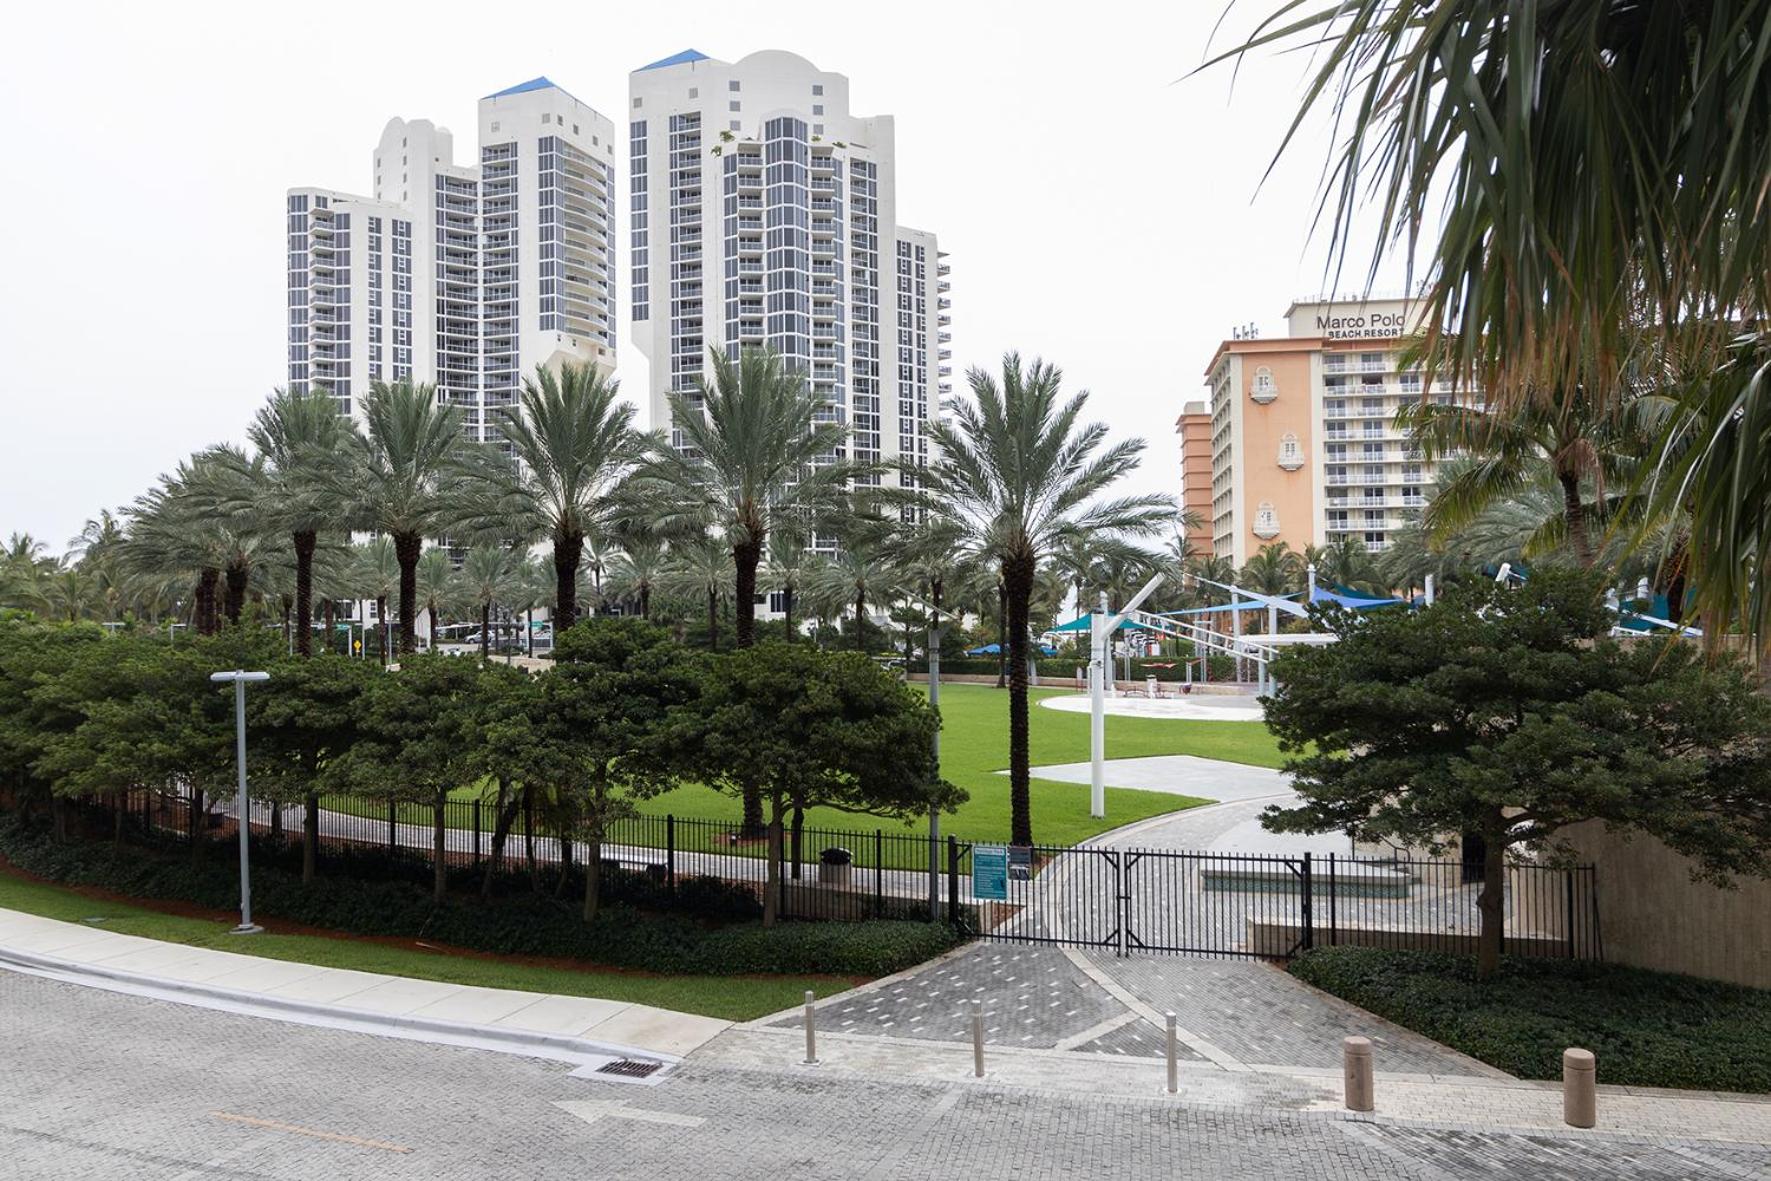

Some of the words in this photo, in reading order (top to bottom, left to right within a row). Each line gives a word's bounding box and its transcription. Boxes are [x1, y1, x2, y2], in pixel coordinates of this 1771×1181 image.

[1317, 316, 1365, 329] Marco
[1371, 313, 1405, 327] Polo
[1328, 330, 1361, 338] BEACH
